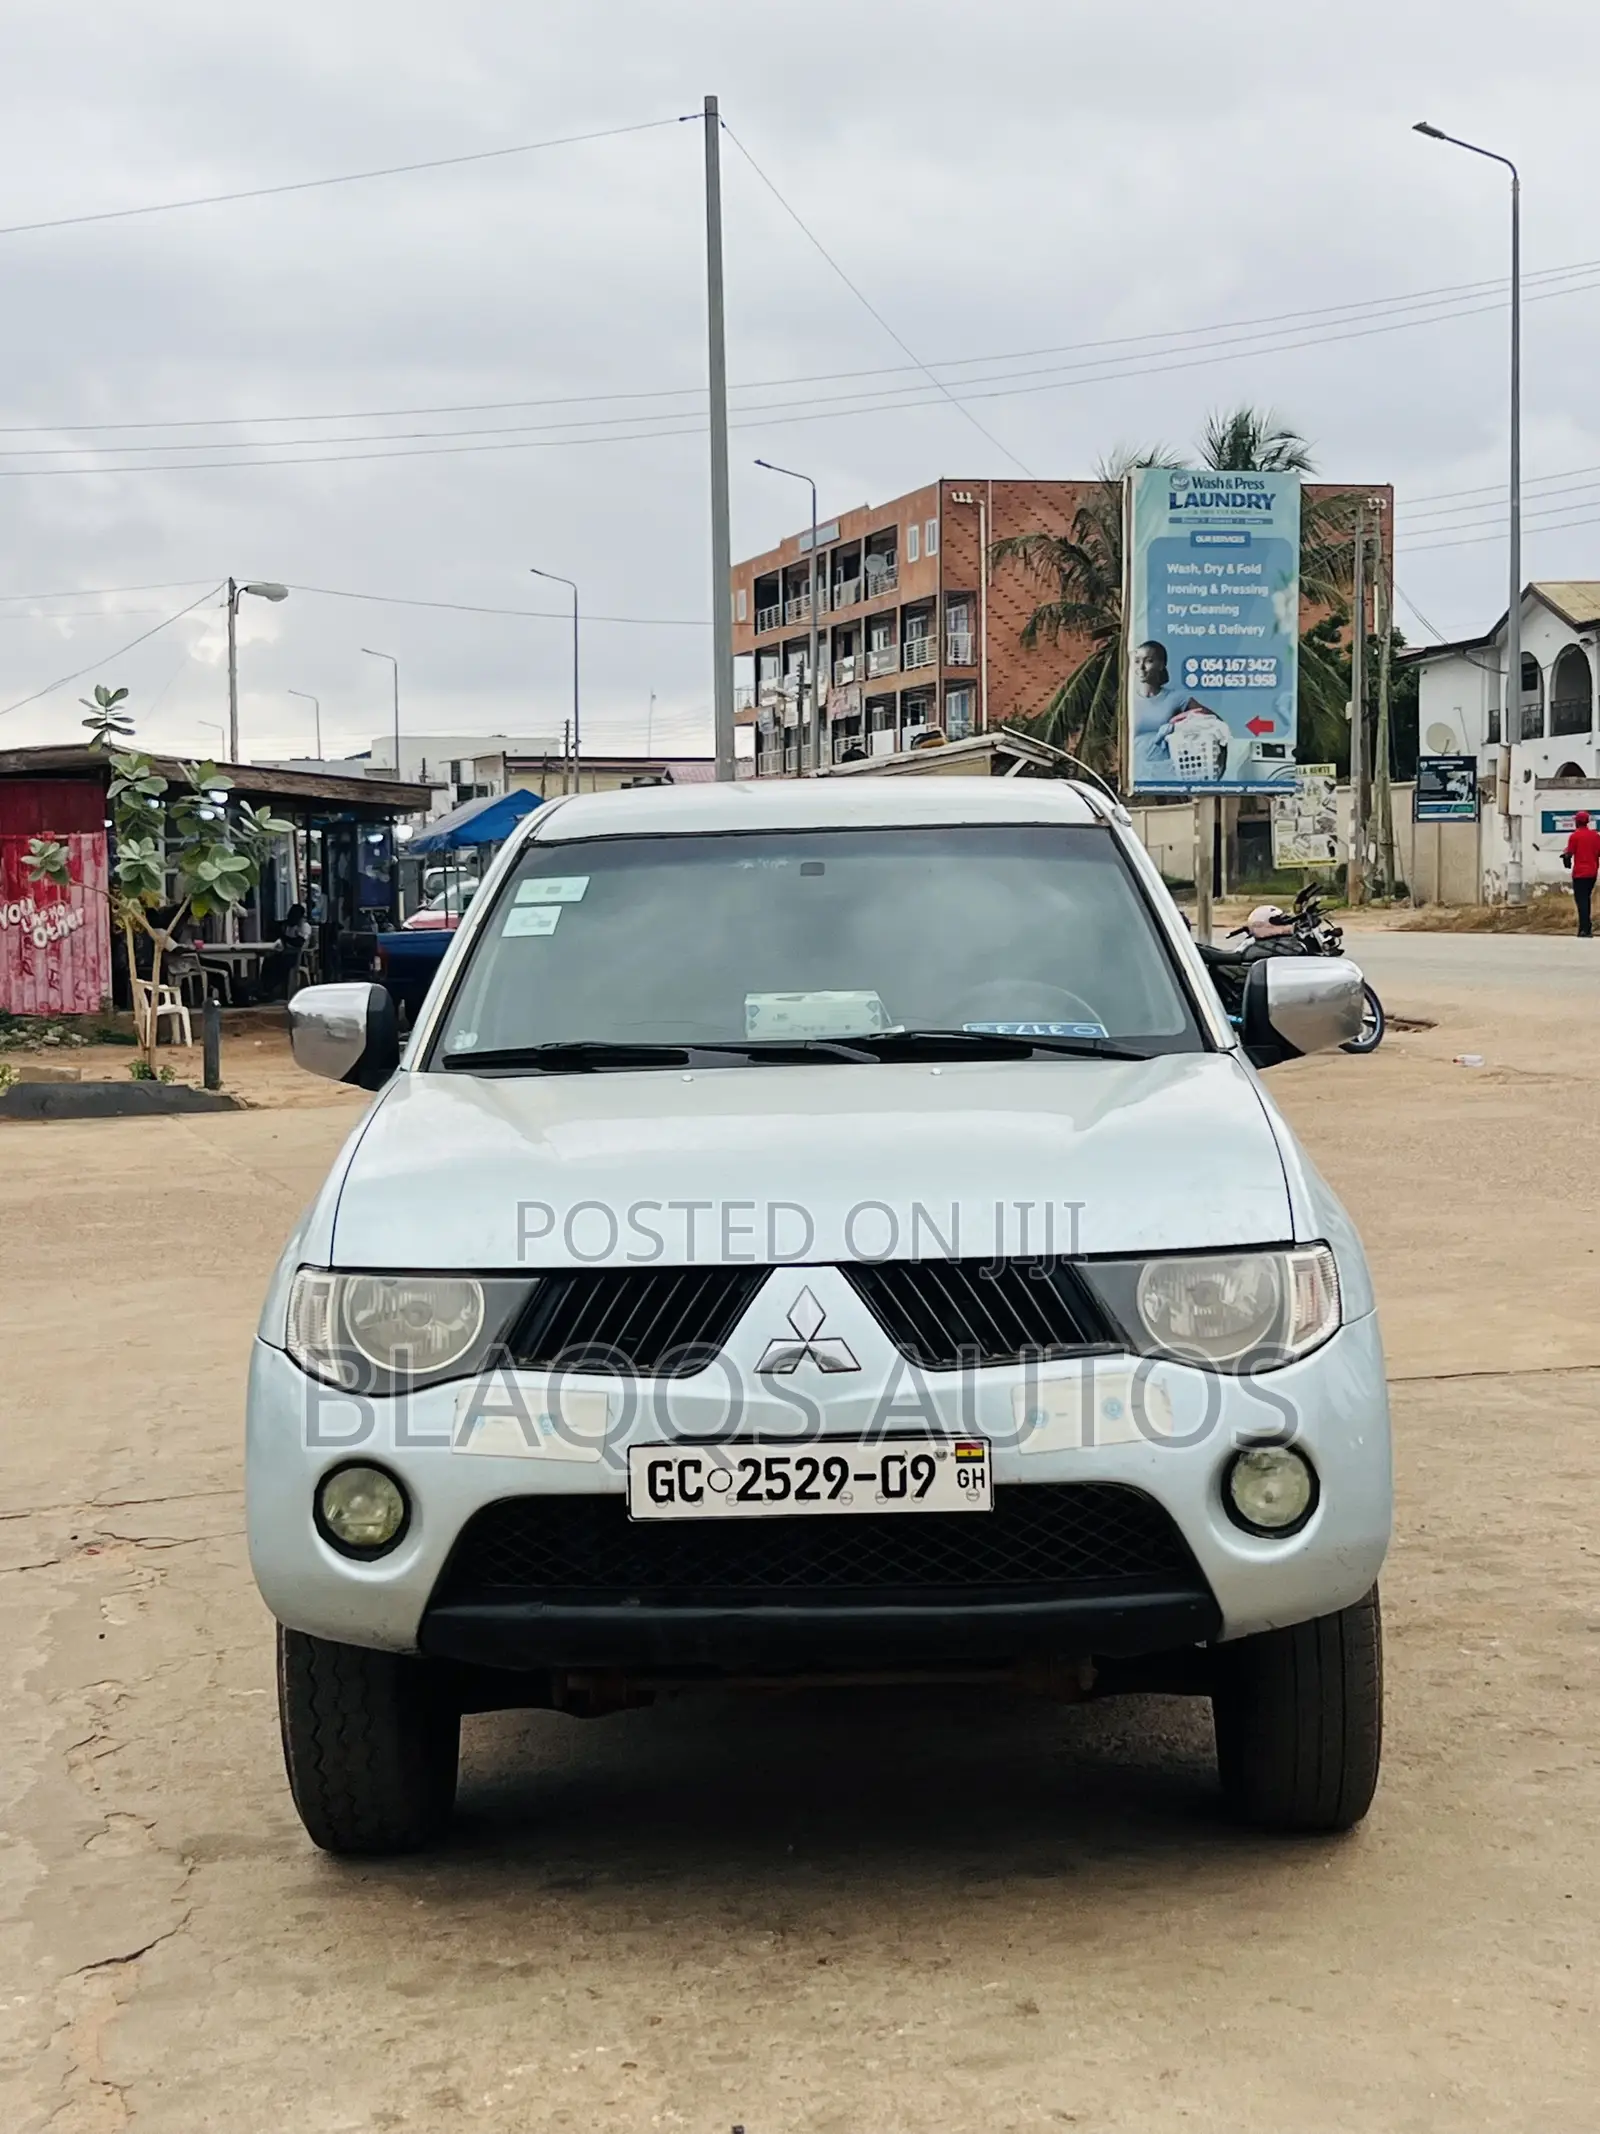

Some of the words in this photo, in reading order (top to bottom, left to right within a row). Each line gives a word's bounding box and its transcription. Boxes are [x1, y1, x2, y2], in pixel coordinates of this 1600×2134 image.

[1192, 476, 1224, 490] Wash
[1235, 477, 1265, 490] Press
[1169, 492, 1276, 510] LAUNDRY
[1167, 563, 1202, 575] Wash,
[1204, 563, 1224, 577] Dry
[1226, 563, 1235, 575] &
[1237, 563, 1262, 575] Fold
[1167, 583, 1208, 597] Ironing
[1210, 583, 1219, 595] &
[1221, 584, 1269, 598] Pressing
[1167, 604, 1187, 617] Dry
[1189, 603, 1240, 617] Cleaning
[1167, 624, 1206, 637] Pickup
[1208, 624, 1217, 635] &
[1219, 624, 1265, 638] Delivery
[1201, 658, 1223, 672] 054
[1247, 658, 1277, 672] 3427
[1201, 673, 1223, 687] 020
[647, 1459, 704, 1504] GC
[957, 1468, 985, 1490] GH
